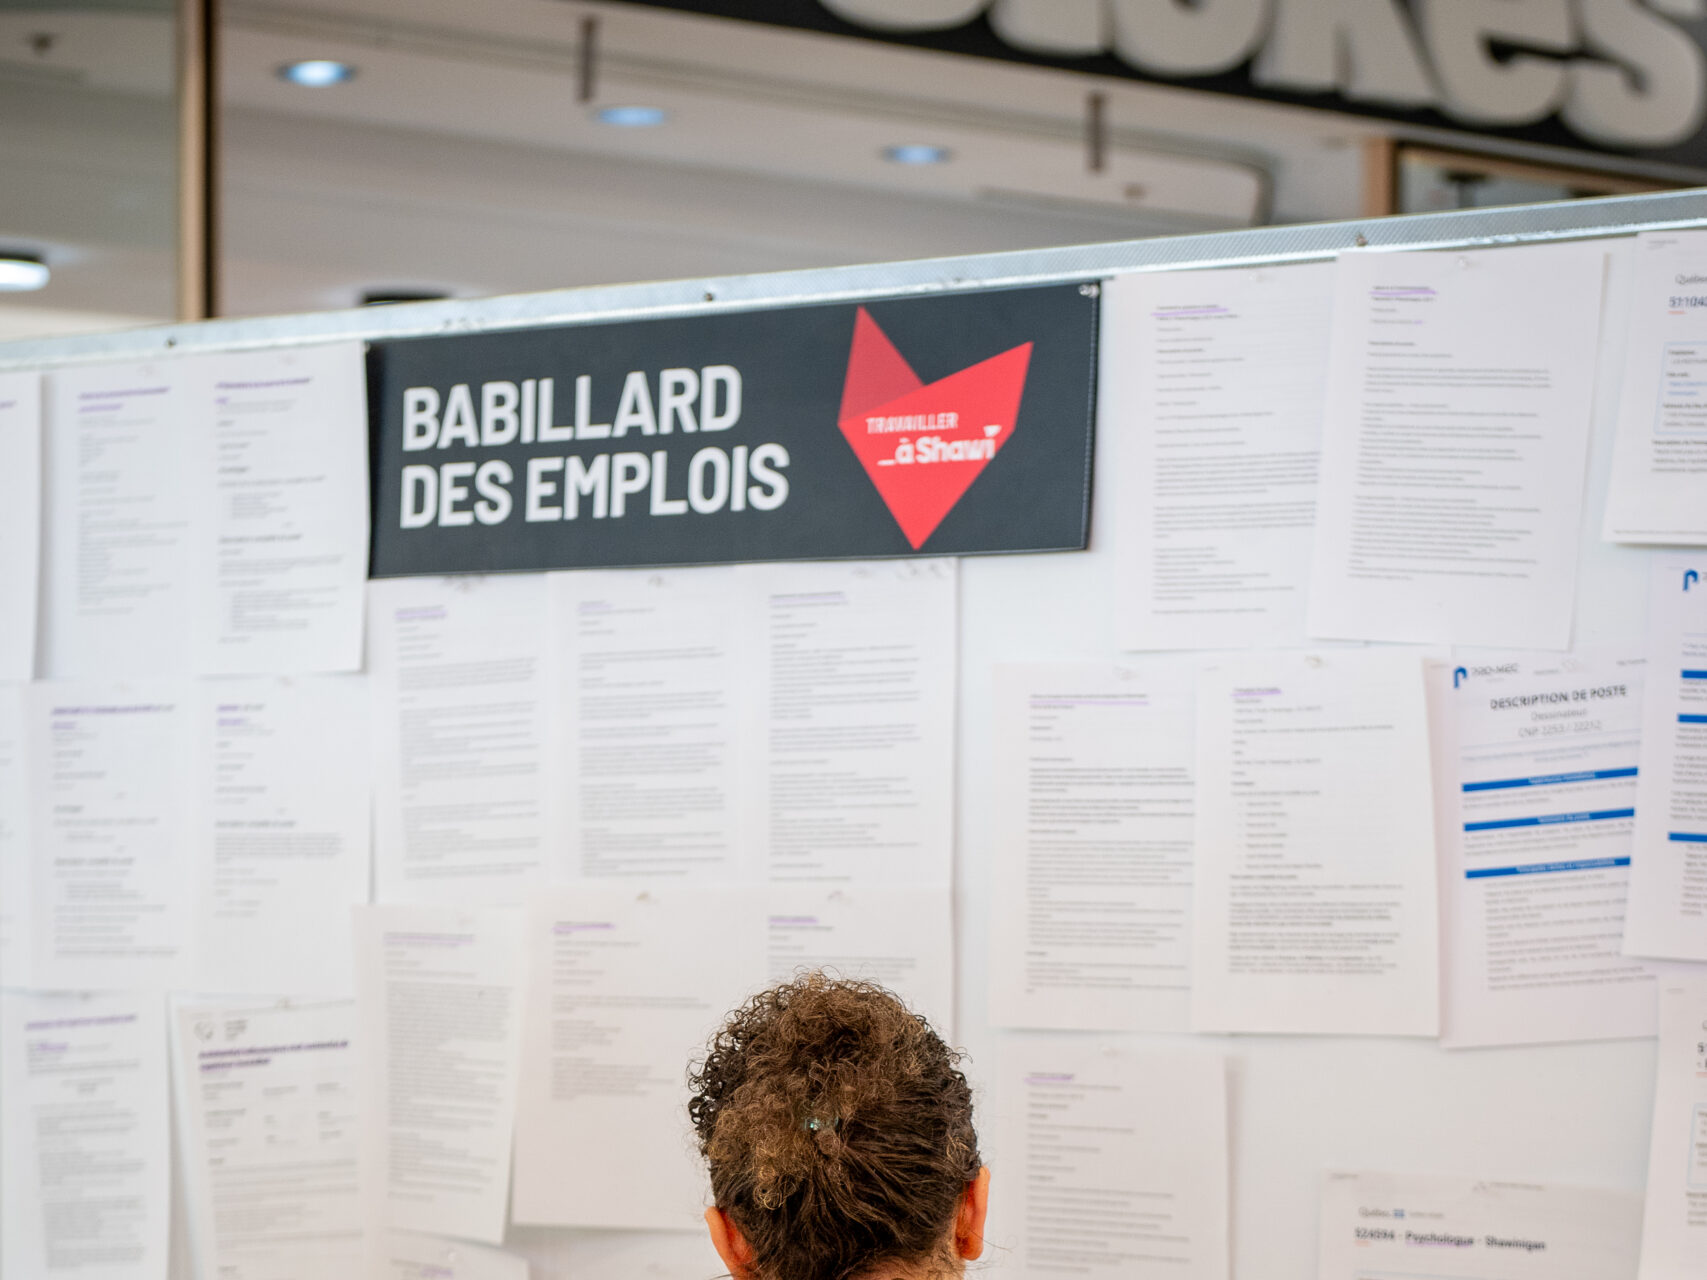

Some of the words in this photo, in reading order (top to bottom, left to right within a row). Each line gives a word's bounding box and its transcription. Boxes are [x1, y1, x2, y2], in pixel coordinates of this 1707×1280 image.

[402, 364, 743, 451] BABILLARD
[866, 412, 959, 434] TRAVAILLER
[401, 459, 514, 529] DES
[525, 442, 790, 522] EMPLOIS
[1490, 692, 1568, 710] DESCRIPTION
[1572, 688, 1587, 701] DE
[1590, 684, 1627, 698] POSTE
